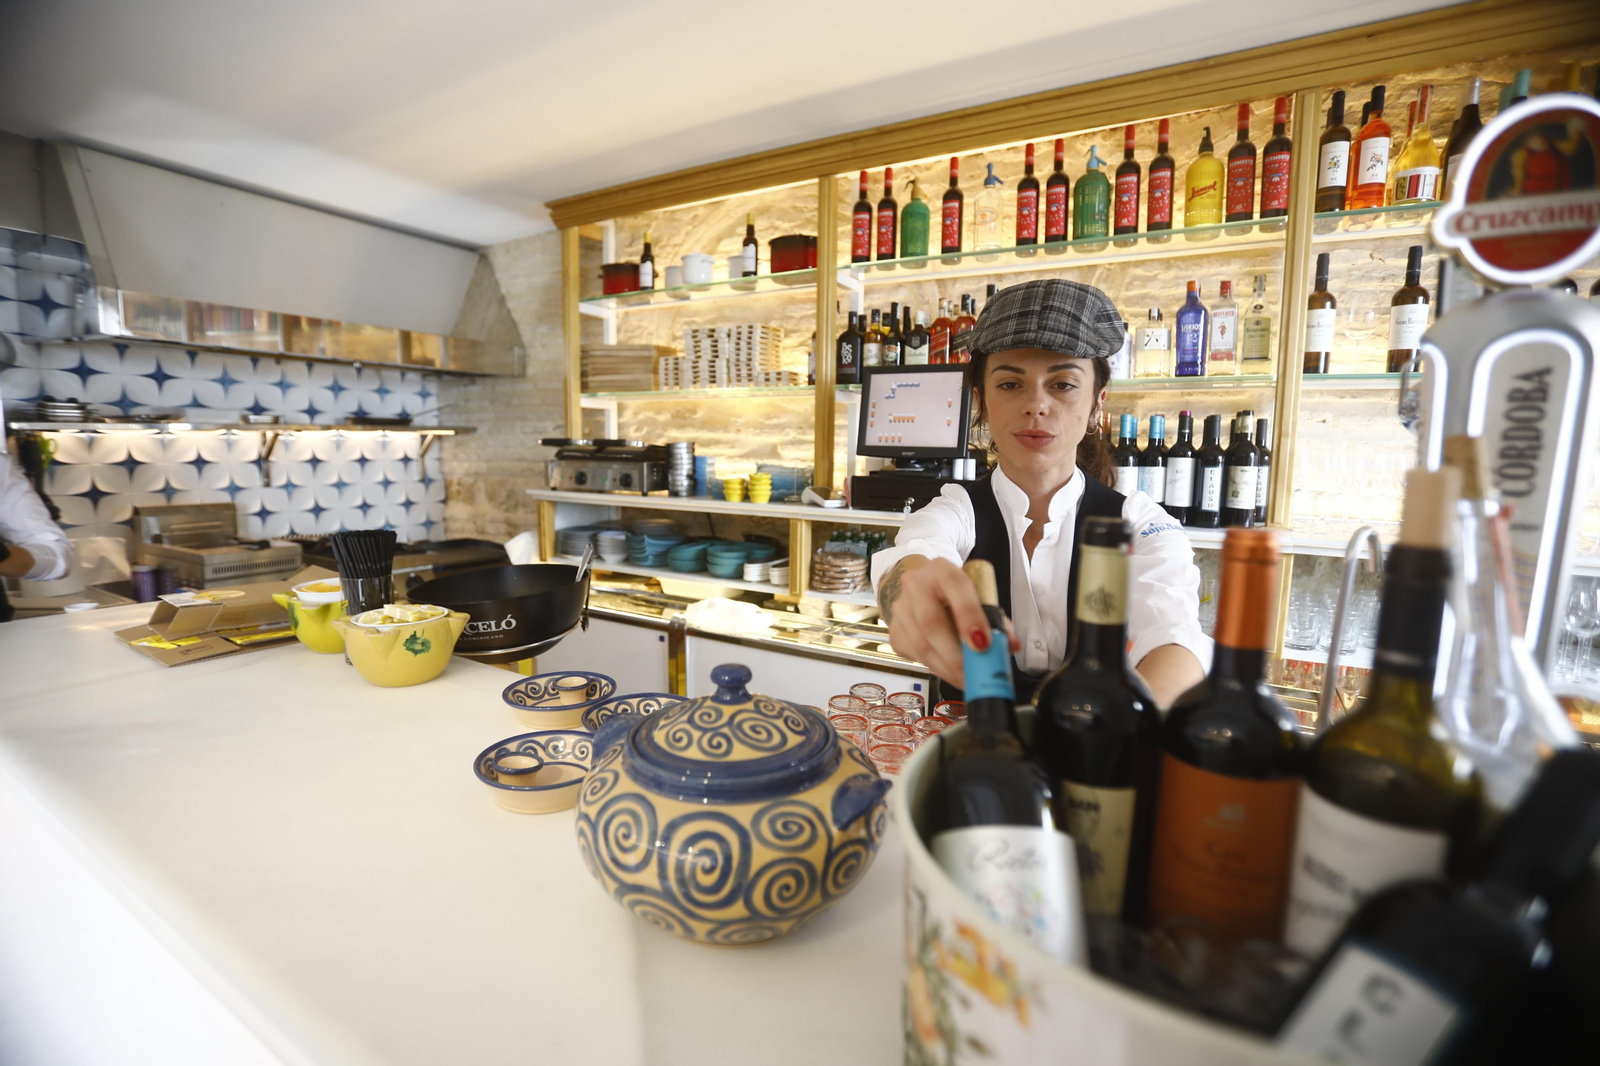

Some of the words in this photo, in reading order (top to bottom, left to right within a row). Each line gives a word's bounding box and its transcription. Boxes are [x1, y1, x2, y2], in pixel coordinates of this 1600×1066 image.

[1229, 158, 1254, 167] VERMOUTH
[1264, 153, 1290, 163] VERMOUTH
[1213, 310, 1235, 318] BEEFEATER
[1182, 323, 1201, 332] LARIOS
[463, 613, 517, 636] CELÓ
[463, 633, 504, 641] DOMINICANO
